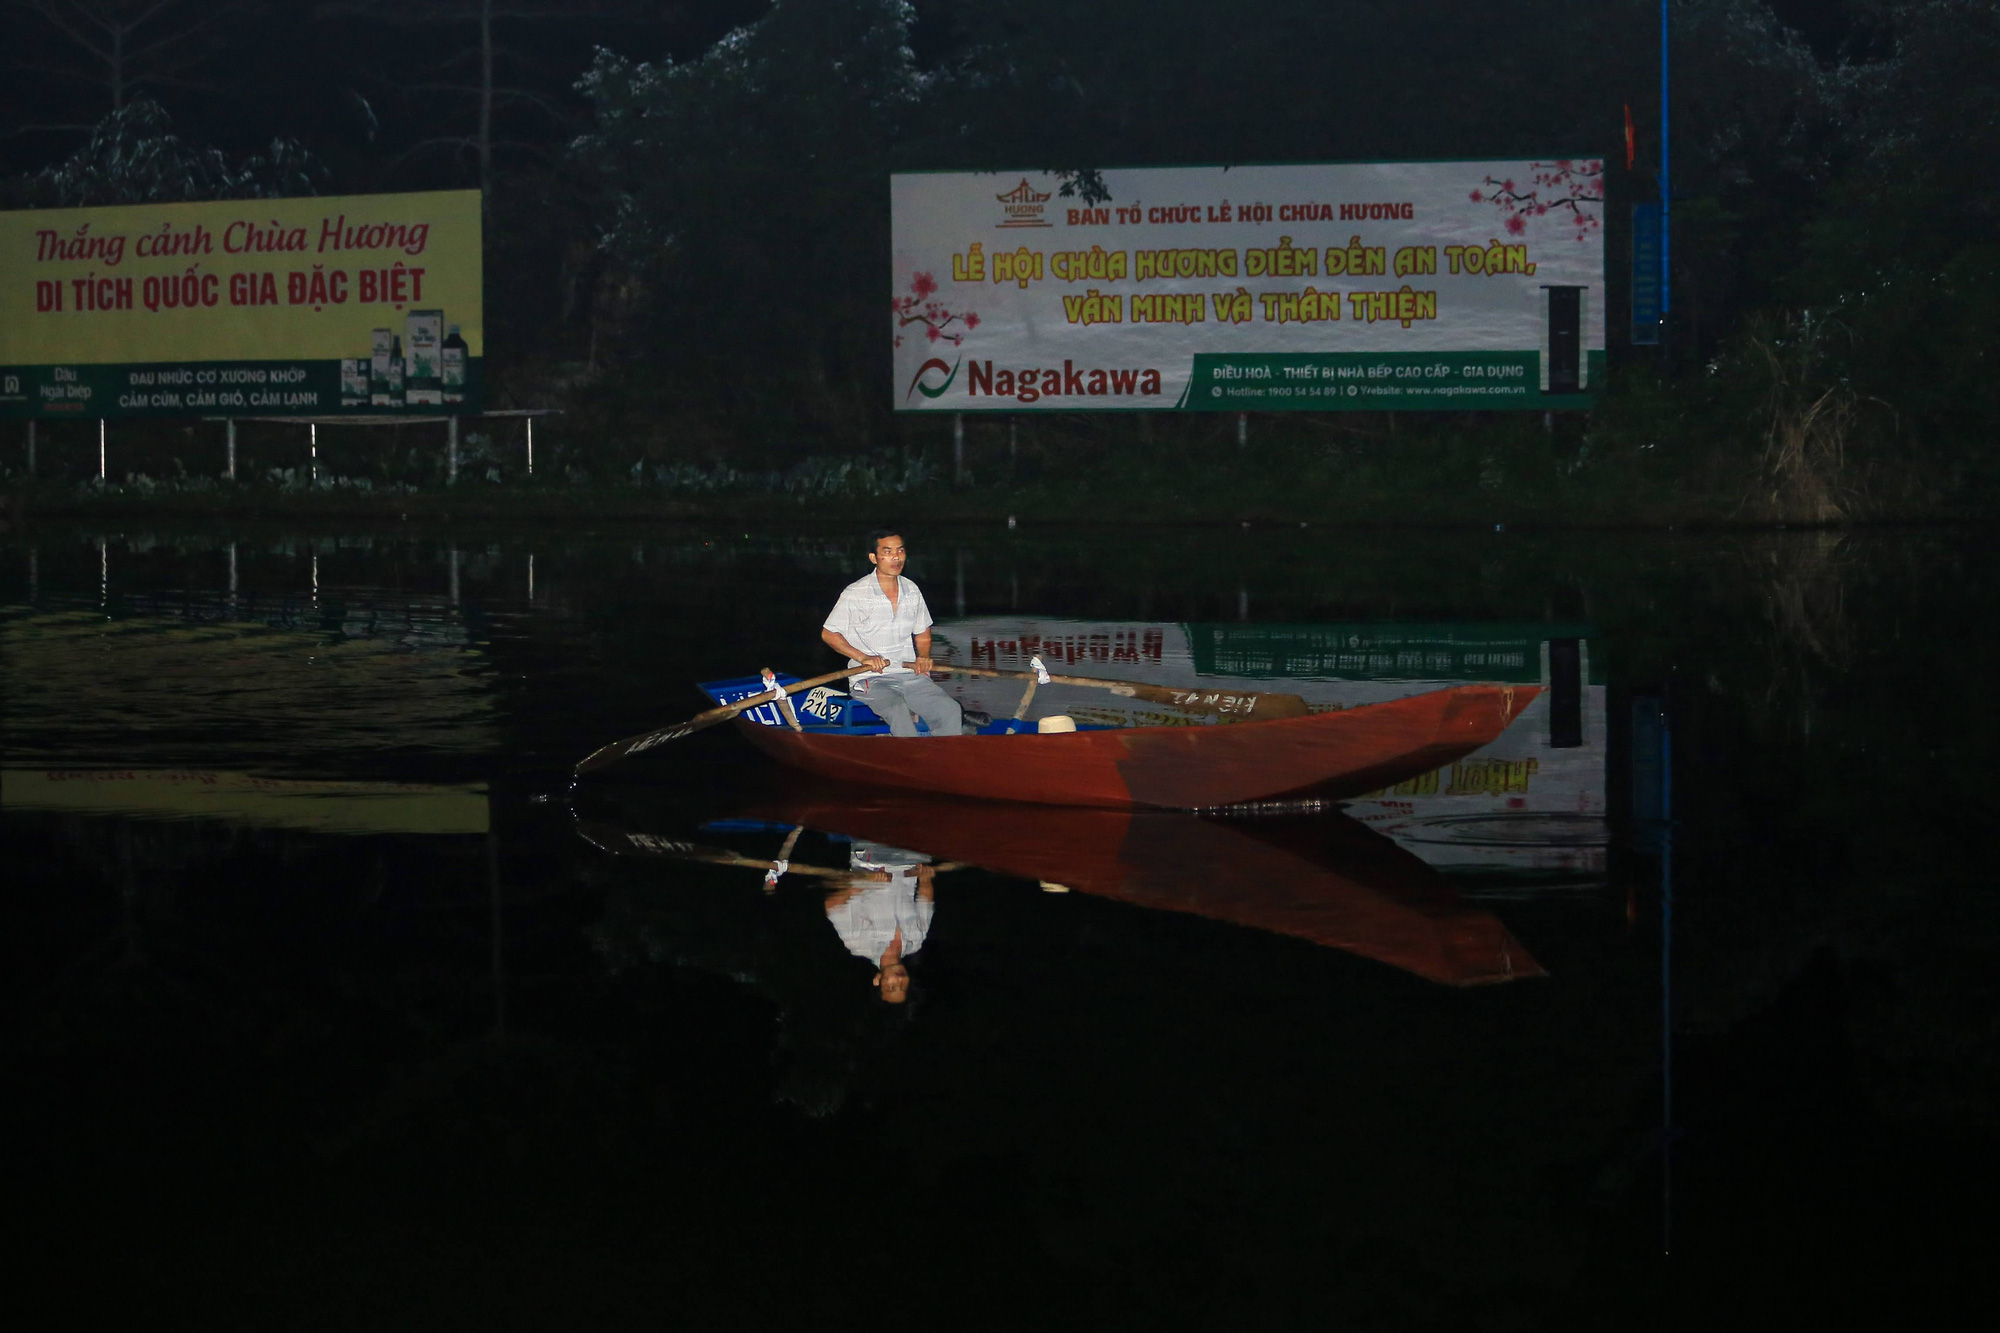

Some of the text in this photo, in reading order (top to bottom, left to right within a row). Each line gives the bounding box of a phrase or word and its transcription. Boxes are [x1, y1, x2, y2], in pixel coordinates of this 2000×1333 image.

[1067, 207, 1110, 225] BAN
[1116, 200, 1142, 224] TỔ
[1148, 203, 1201, 224] CHỨC
[1207, 199, 1232, 223] LỄ
[1238, 202, 1273, 225] HỘI
[1340, 203, 1413, 221] HƯƠNG
[36, 214, 430, 266] Thắng cảnh Chùa Hương
[953, 235, 1537, 289] LỄ HỘI CHÙA HƯƠNG ĐIỂM ĐẾN AN TOÀN,
[36, 261, 426, 313] DI TÍCH QUỐC GIA ĐẶC BIỆT
[1062, 284, 1437, 329] VĂN MINH VÀ THÂN THIỆN
[129, 371, 155, 386] ĐAU
[158, 368, 193, 385] NHỨC
[968, 359, 1162, 403] Nagakawa
[1212, 364, 1243, 379] ĐIỀU
[1245, 365, 1272, 379] HOÀ
[1283, 364, 1318, 379] THIẾT
[1322, 366, 1334, 381] BỊ
[1338, 365, 1365, 379] NHÀ
[1367, 363, 1393, 378] BẾP
[1395, 366, 1422, 378] CAO
[1424, 363, 1450, 378] CẤP
[1462, 366, 1485, 378] GIA
[1487, 365, 1524, 380] DỤNG
[284, 392, 318, 409] LẠNH
[1227, 386, 1265, 397] Hotline:
[1268, 386, 1292, 397] 1900
[1294, 386, 1307, 397] 54
[1309, 386, 1321, 397] 54
[1406, 384, 1525, 397] www.nagakawa.com.vn
[811, 689, 826, 699] HN
